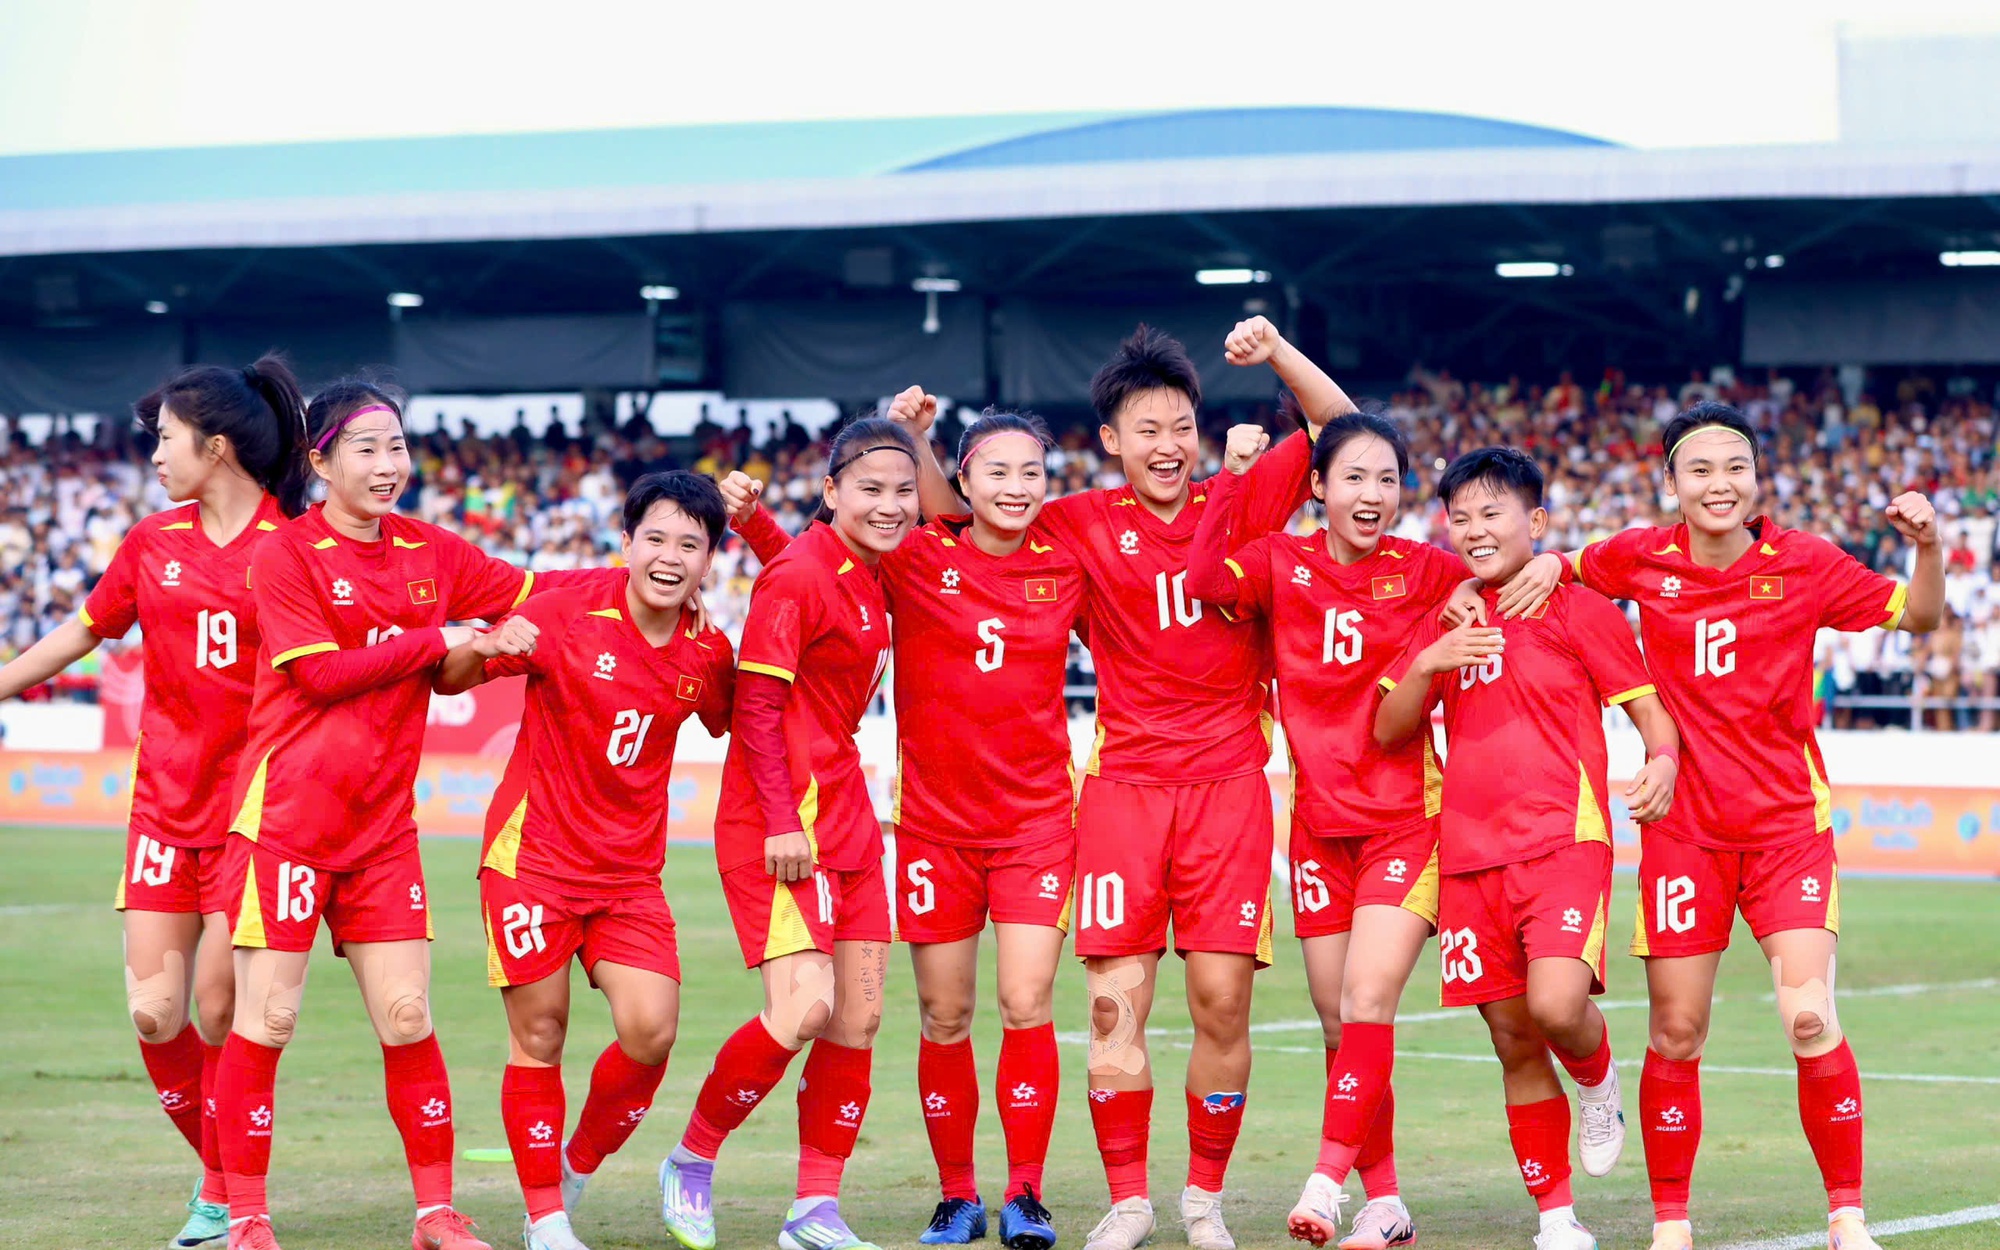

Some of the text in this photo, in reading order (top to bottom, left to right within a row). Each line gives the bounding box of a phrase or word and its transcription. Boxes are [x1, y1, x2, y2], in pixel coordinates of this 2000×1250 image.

[1155, 569, 1203, 631] 10
[196, 609, 237, 669] 19
[975, 618, 1006, 673] 5
[1322, 607, 1364, 665] 15
[1694, 618, 1737, 678] 12
[606, 708, 655, 767] 21
[131, 834, 176, 887] 19
[907, 858, 935, 916] 5
[1294, 858, 1330, 914] 15
[277, 861, 316, 922] 13
[815, 871, 834, 925] 11
[1080, 871, 1125, 930] 10
[1656, 875, 1696, 934] 12
[502, 902, 547, 959] 21
[1441, 926, 1483, 984] 23
